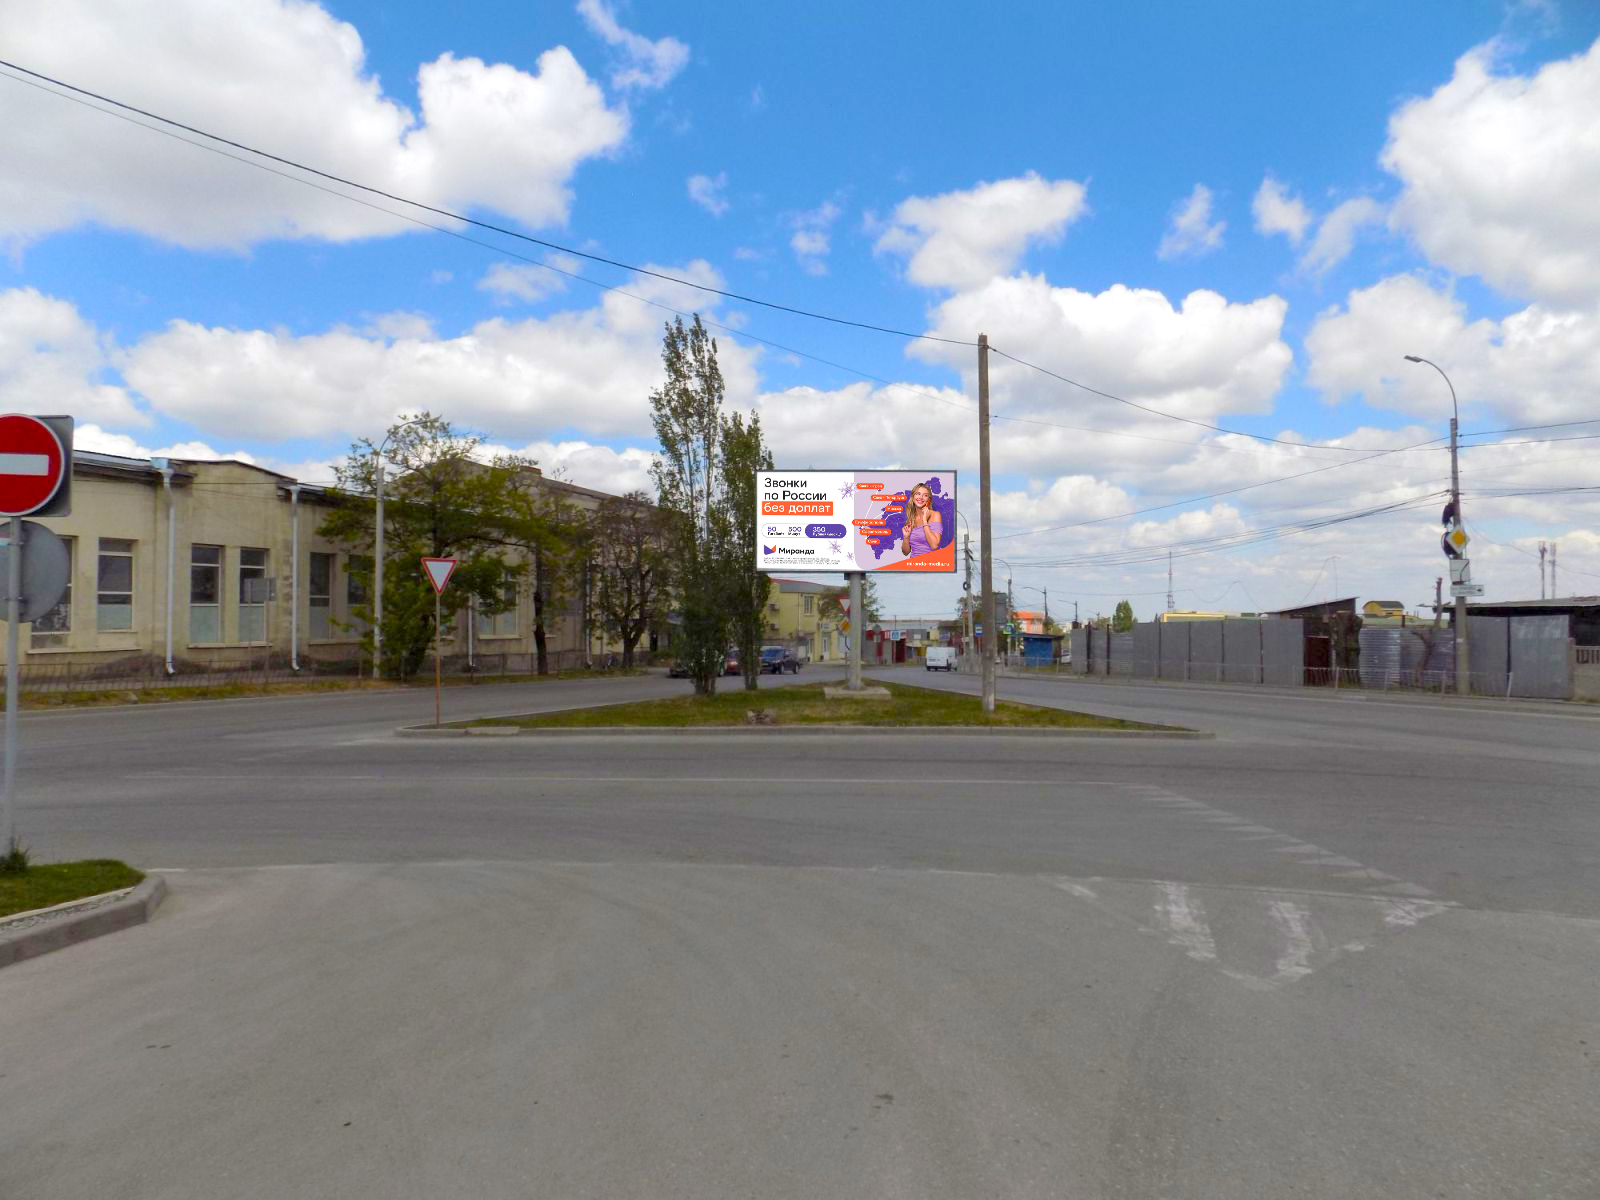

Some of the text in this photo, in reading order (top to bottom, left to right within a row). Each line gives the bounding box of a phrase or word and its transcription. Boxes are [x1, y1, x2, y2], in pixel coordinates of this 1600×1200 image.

[764, 477, 807, 488] Звонки
[764, 490, 827, 500] по России
[764, 502, 831, 514] без доплат
[778, 547, 815, 556] Миранда
